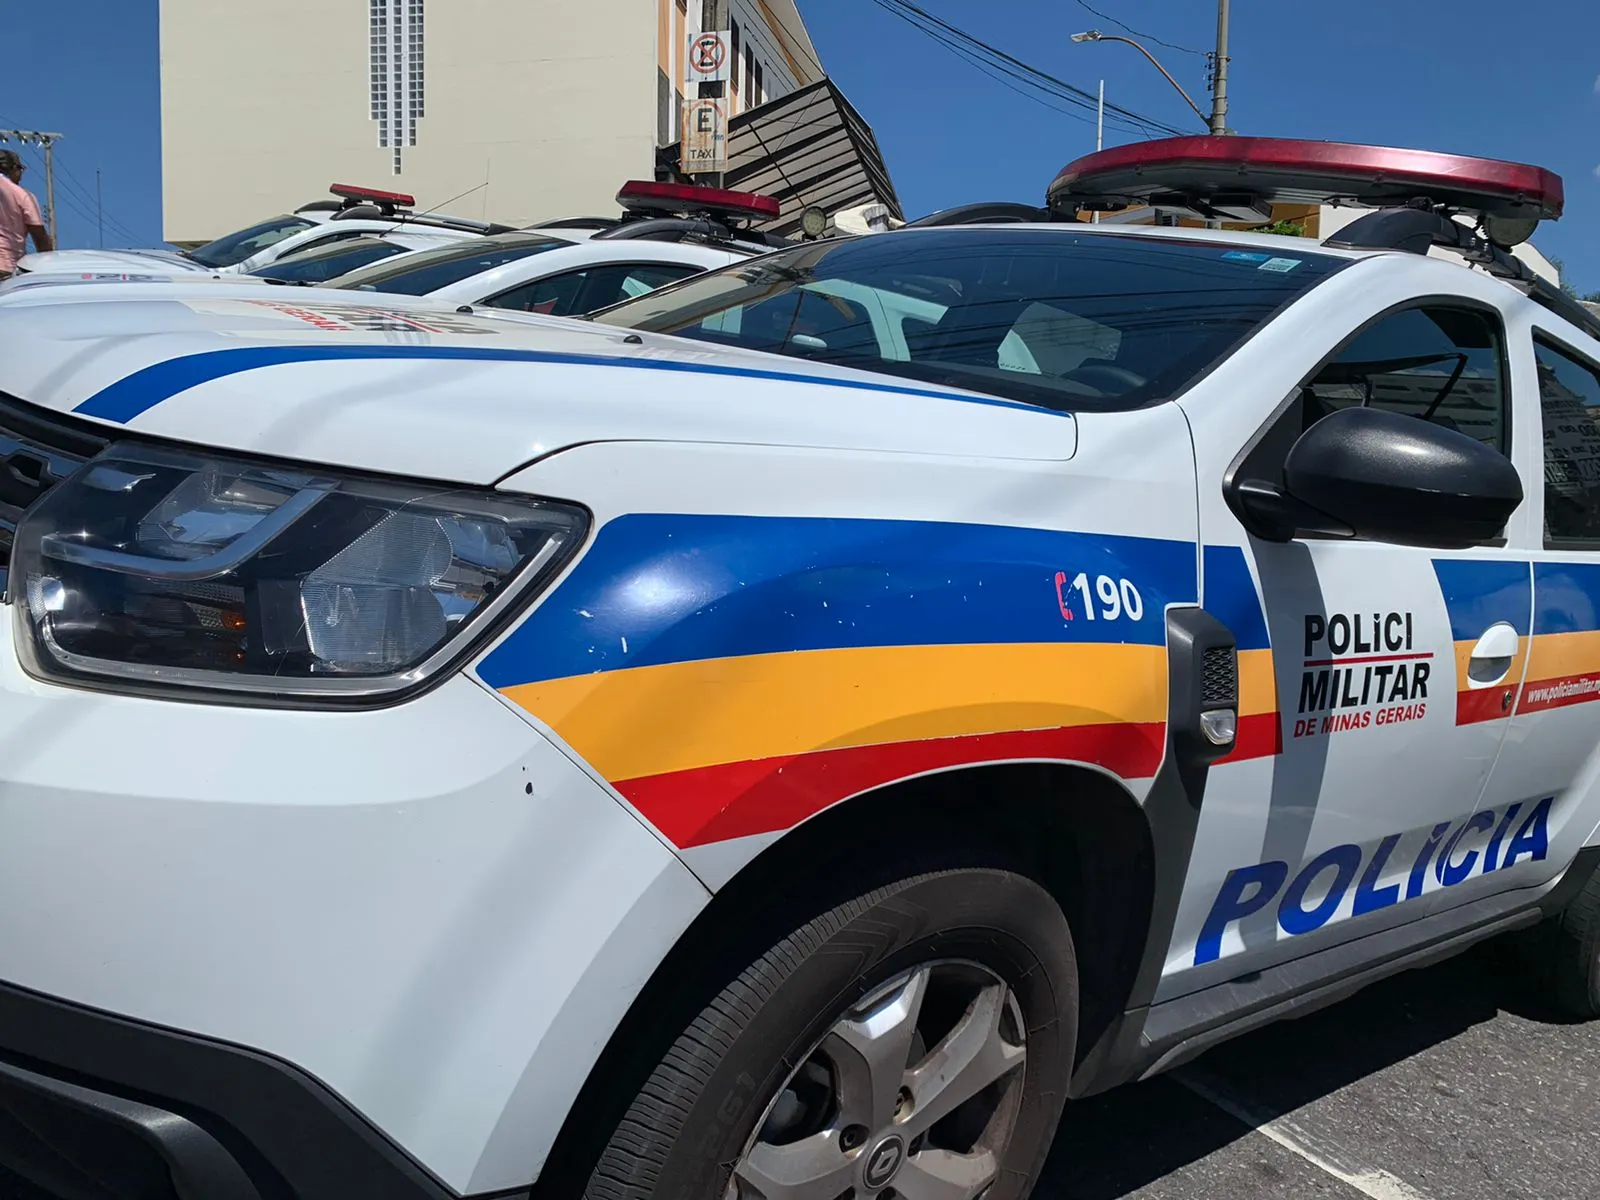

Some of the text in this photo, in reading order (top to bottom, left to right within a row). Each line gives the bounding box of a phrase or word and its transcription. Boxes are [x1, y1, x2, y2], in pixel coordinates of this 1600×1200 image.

[697, 107, 713, 133] E
[1072, 572, 1144, 622] 190
[1298, 662, 1431, 714] MILITAR
[1293, 703, 1427, 738] DE MINAS GERAIS
